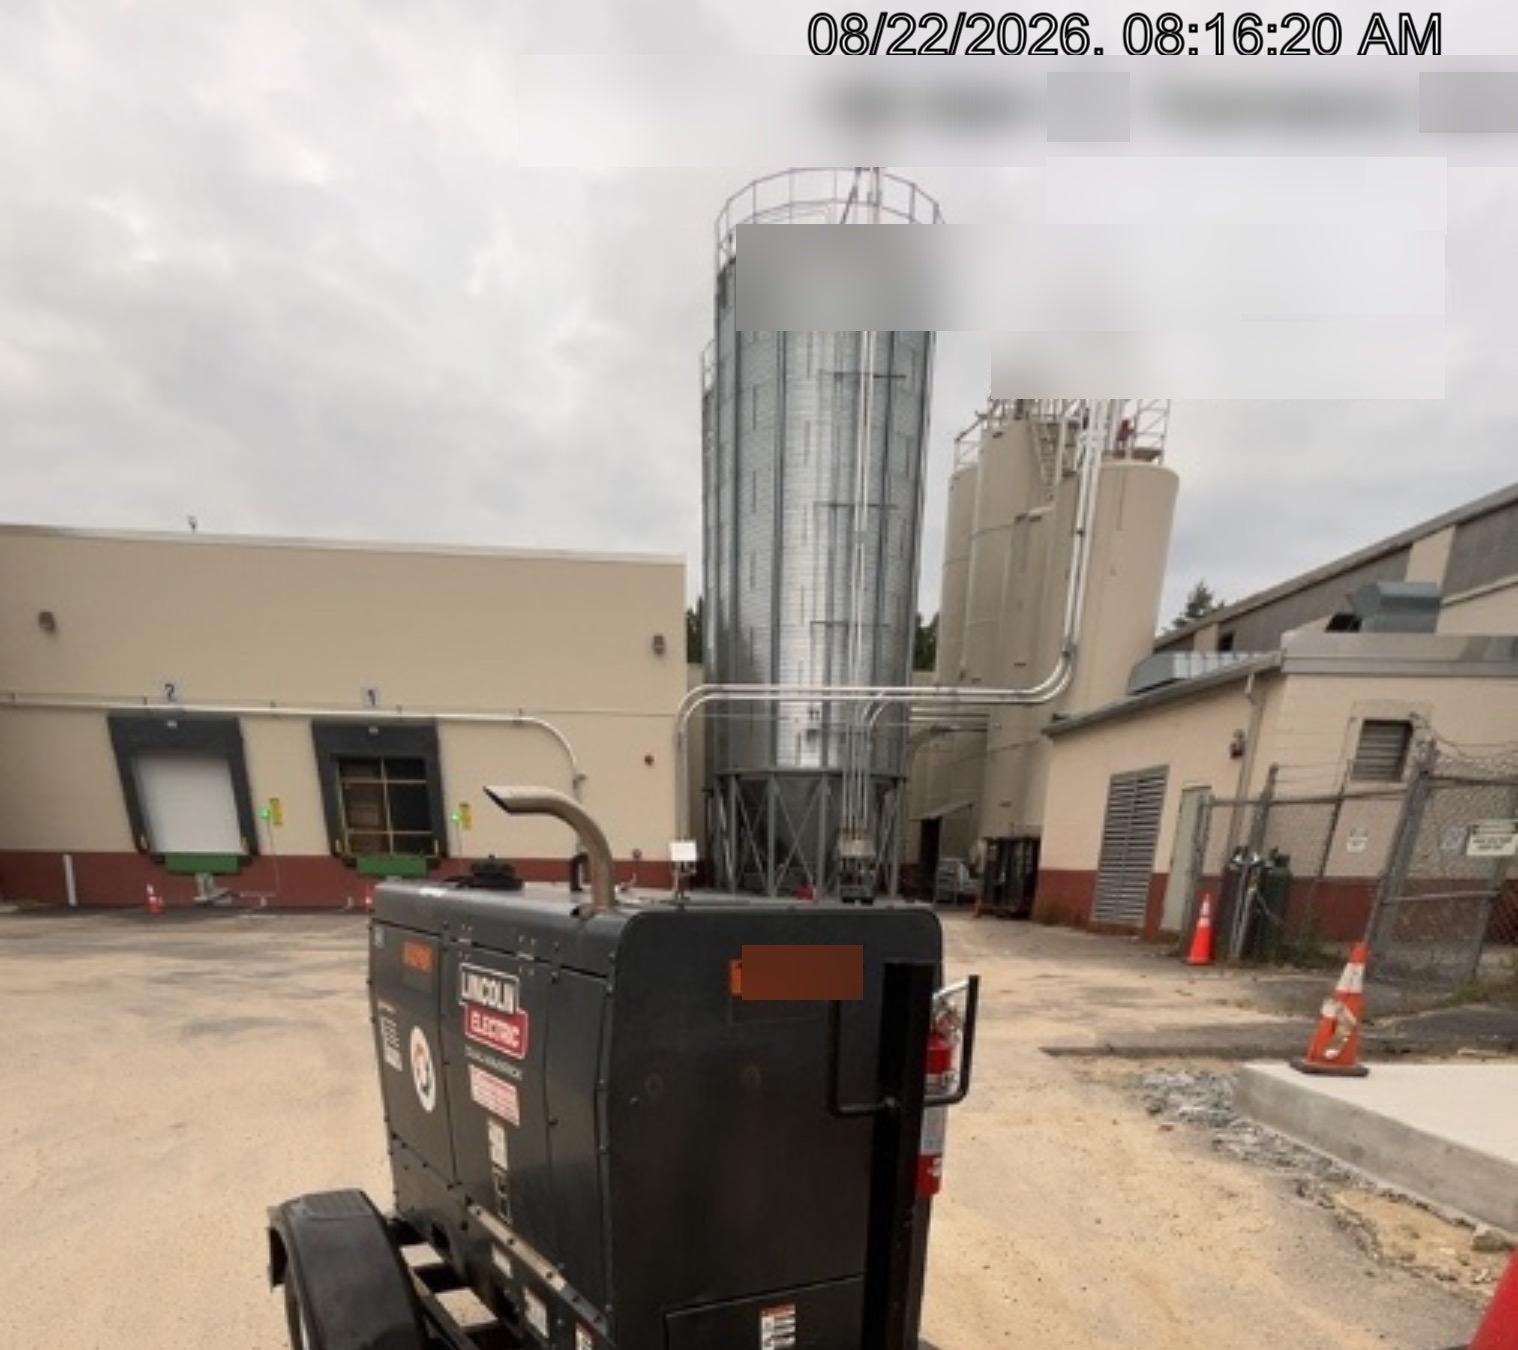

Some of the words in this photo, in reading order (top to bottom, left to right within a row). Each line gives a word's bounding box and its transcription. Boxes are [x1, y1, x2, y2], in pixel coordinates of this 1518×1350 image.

[164, 682, 176, 702] 2
[461, 970, 515, 1014] LINCOLN
[470, 1009, 521, 1048] ELECTRIC
